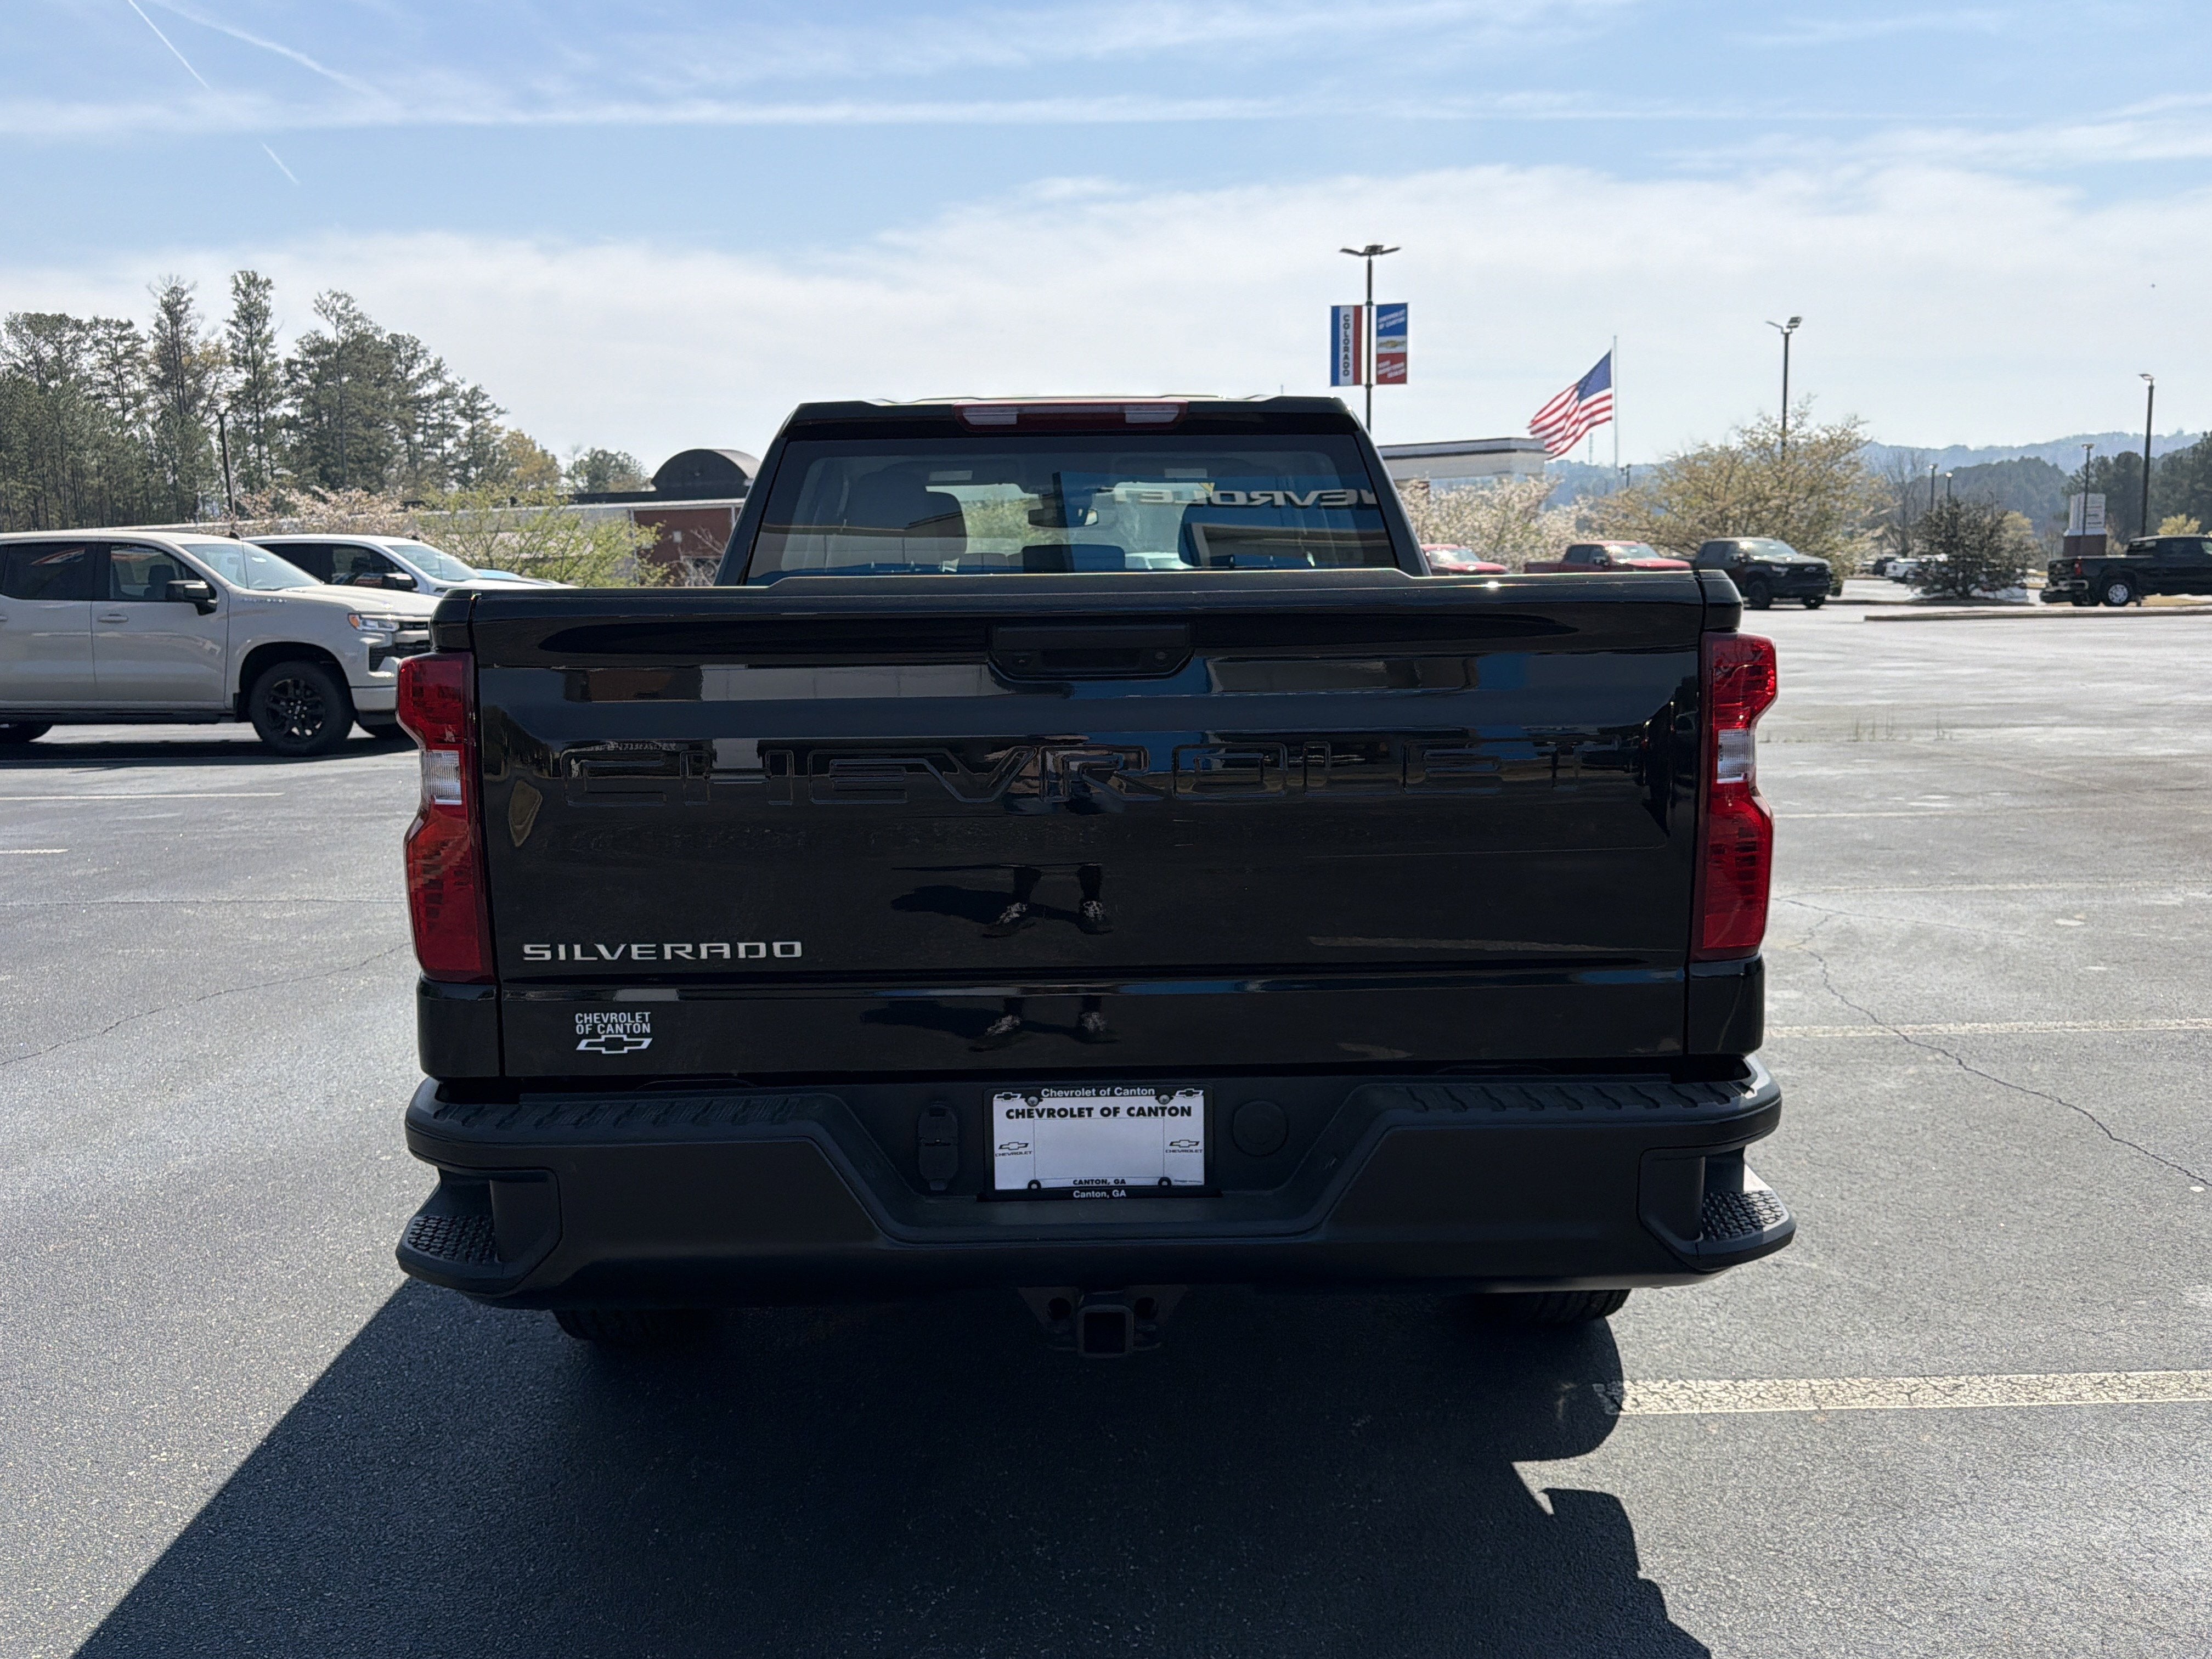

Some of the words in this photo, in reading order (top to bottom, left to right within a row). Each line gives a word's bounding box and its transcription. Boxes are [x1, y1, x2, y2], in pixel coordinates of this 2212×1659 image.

[560, 736, 1622, 808] CHEVROLET
[522, 941, 803, 961] SILVERADO
[575, 1012, 651, 1024] CHEVROLET
[575, 1024, 592, 1035] OF
[597, 1023, 651, 1034] CANTON
[1041, 1088, 1096, 1097] Chevrolet
[1099, 1087, 1111, 1096] of
[1116, 1087, 1155, 1096] Canton
[1006, 1107, 1094, 1119] CHEVROLET
[1100, 1107, 1120, 1117] OF
[1126, 1106, 1192, 1117] CANTON
[1073, 1190, 1110, 1198] Canton,
[1112, 1189, 1127, 1198] GA
